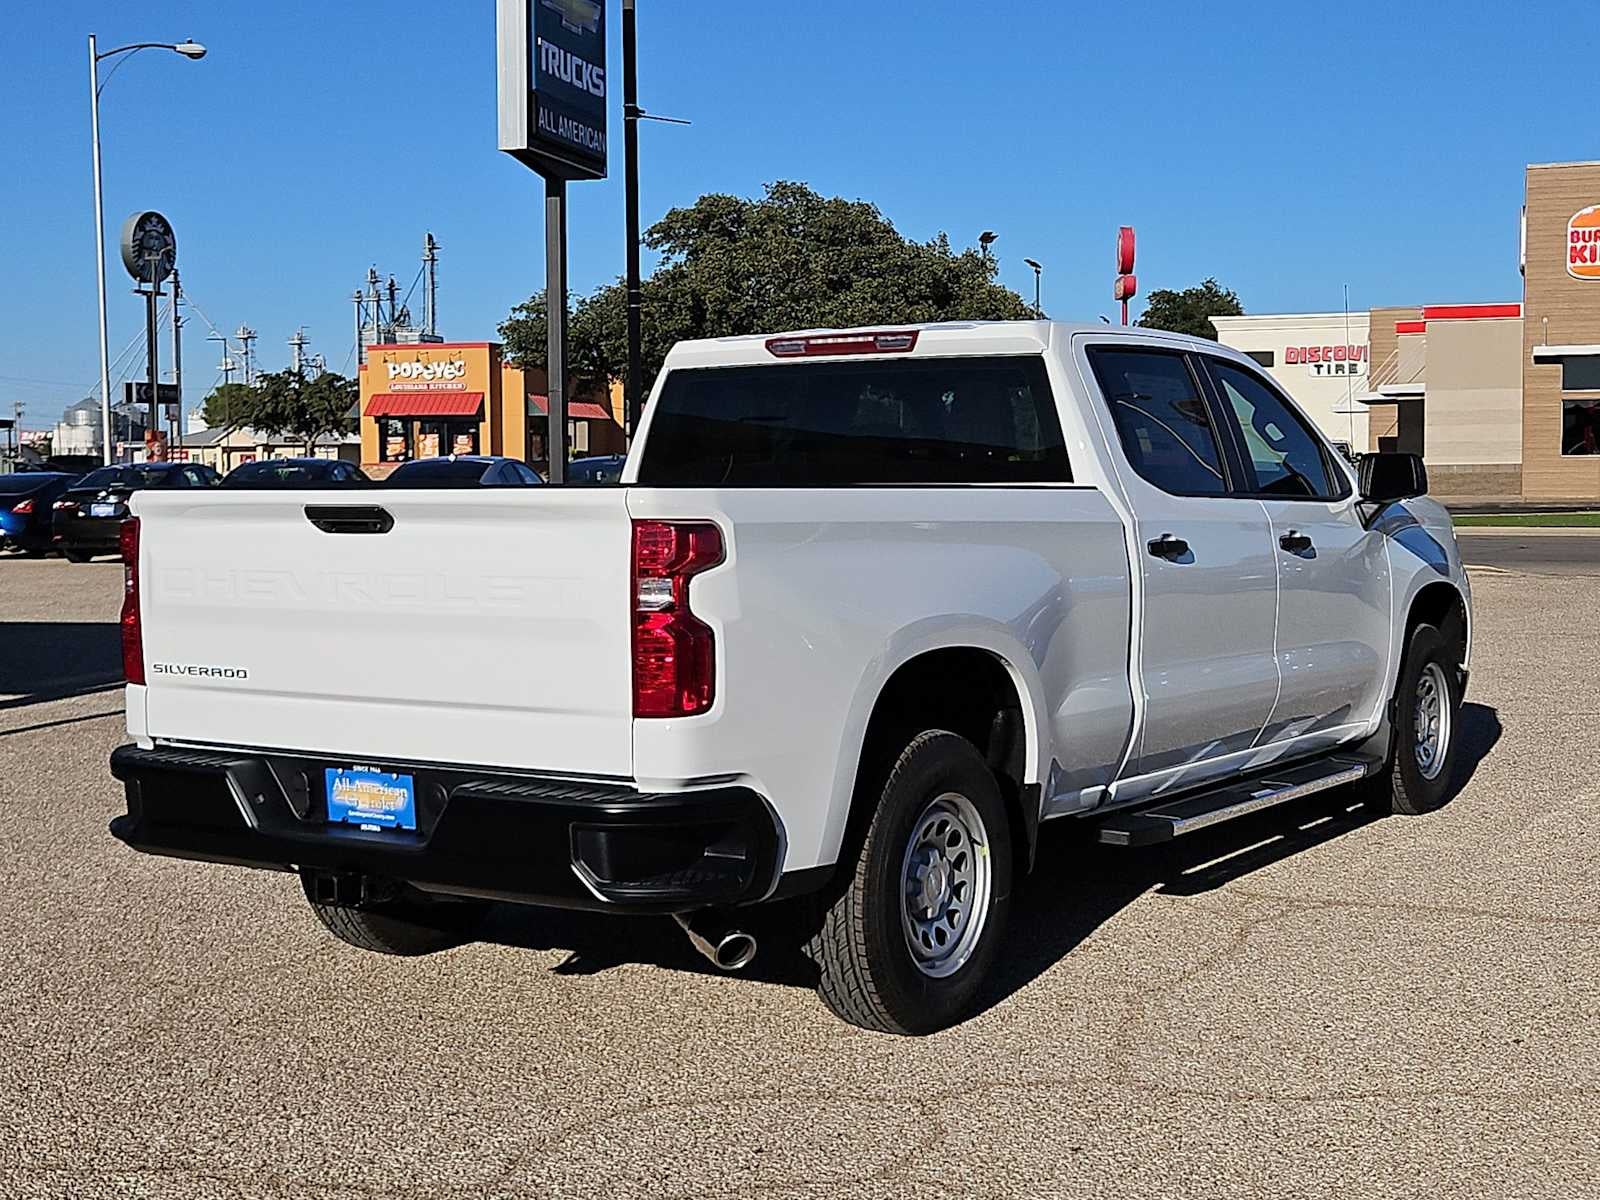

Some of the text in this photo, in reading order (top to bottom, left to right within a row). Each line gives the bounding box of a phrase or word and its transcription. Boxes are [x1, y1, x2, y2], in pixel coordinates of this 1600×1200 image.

[541, 39, 604, 97] TRUCKS
[539, 106, 605, 152] ALL AMERICAN
[1570, 245, 1600, 263] KI
[1314, 363, 1358, 375] TIRE
[158, 568, 584, 606] CHEVROLET
[153, 664, 247, 679] SILVERADO
